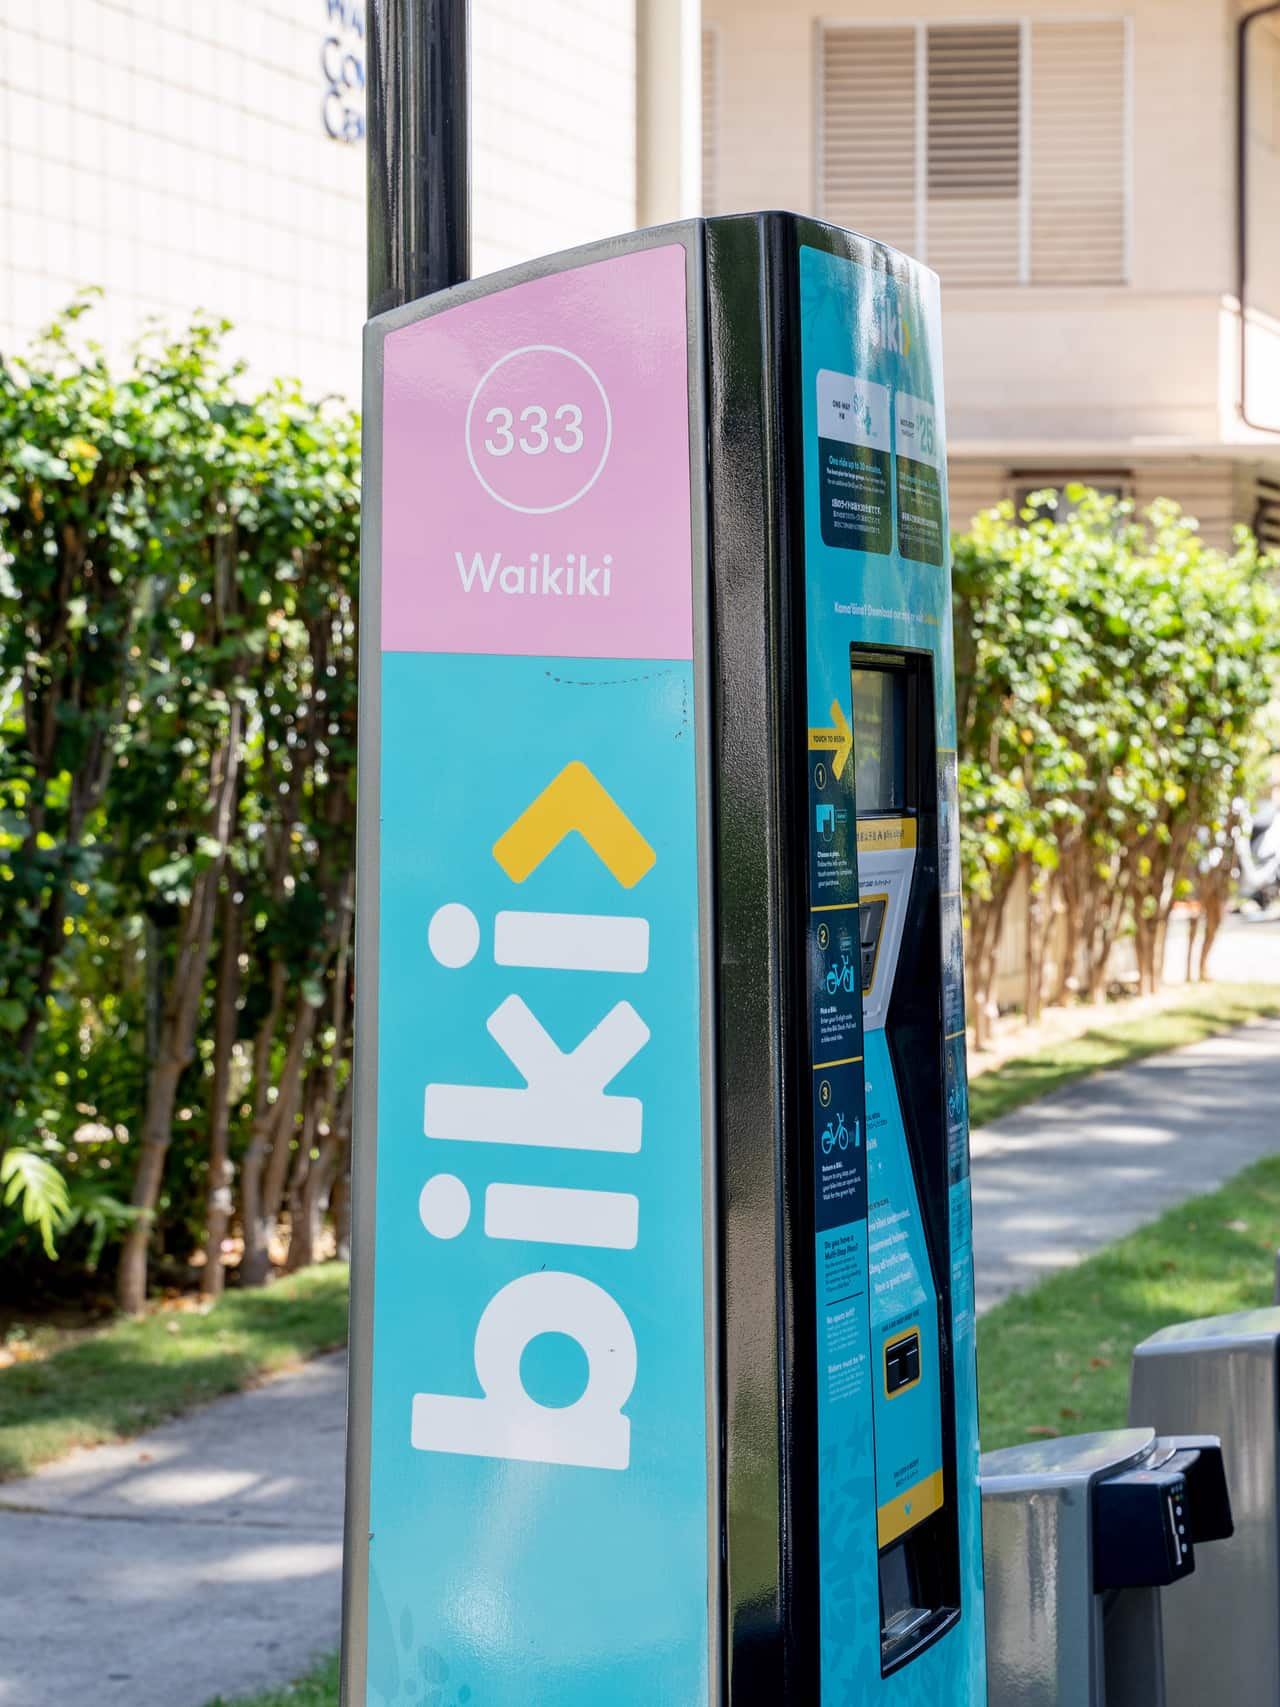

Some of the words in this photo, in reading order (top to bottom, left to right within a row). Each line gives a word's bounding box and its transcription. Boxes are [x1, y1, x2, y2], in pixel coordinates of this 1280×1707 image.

[485, 404, 584, 456] 333
[454, 550, 613, 596] Waikiki
[813, 735, 827, 743] TOUCH
[828, 735, 833, 743] TO
[821, 932, 826, 944] 2
[823, 1087, 828, 1100] 3
[411, 902, 651, 1471] biki
